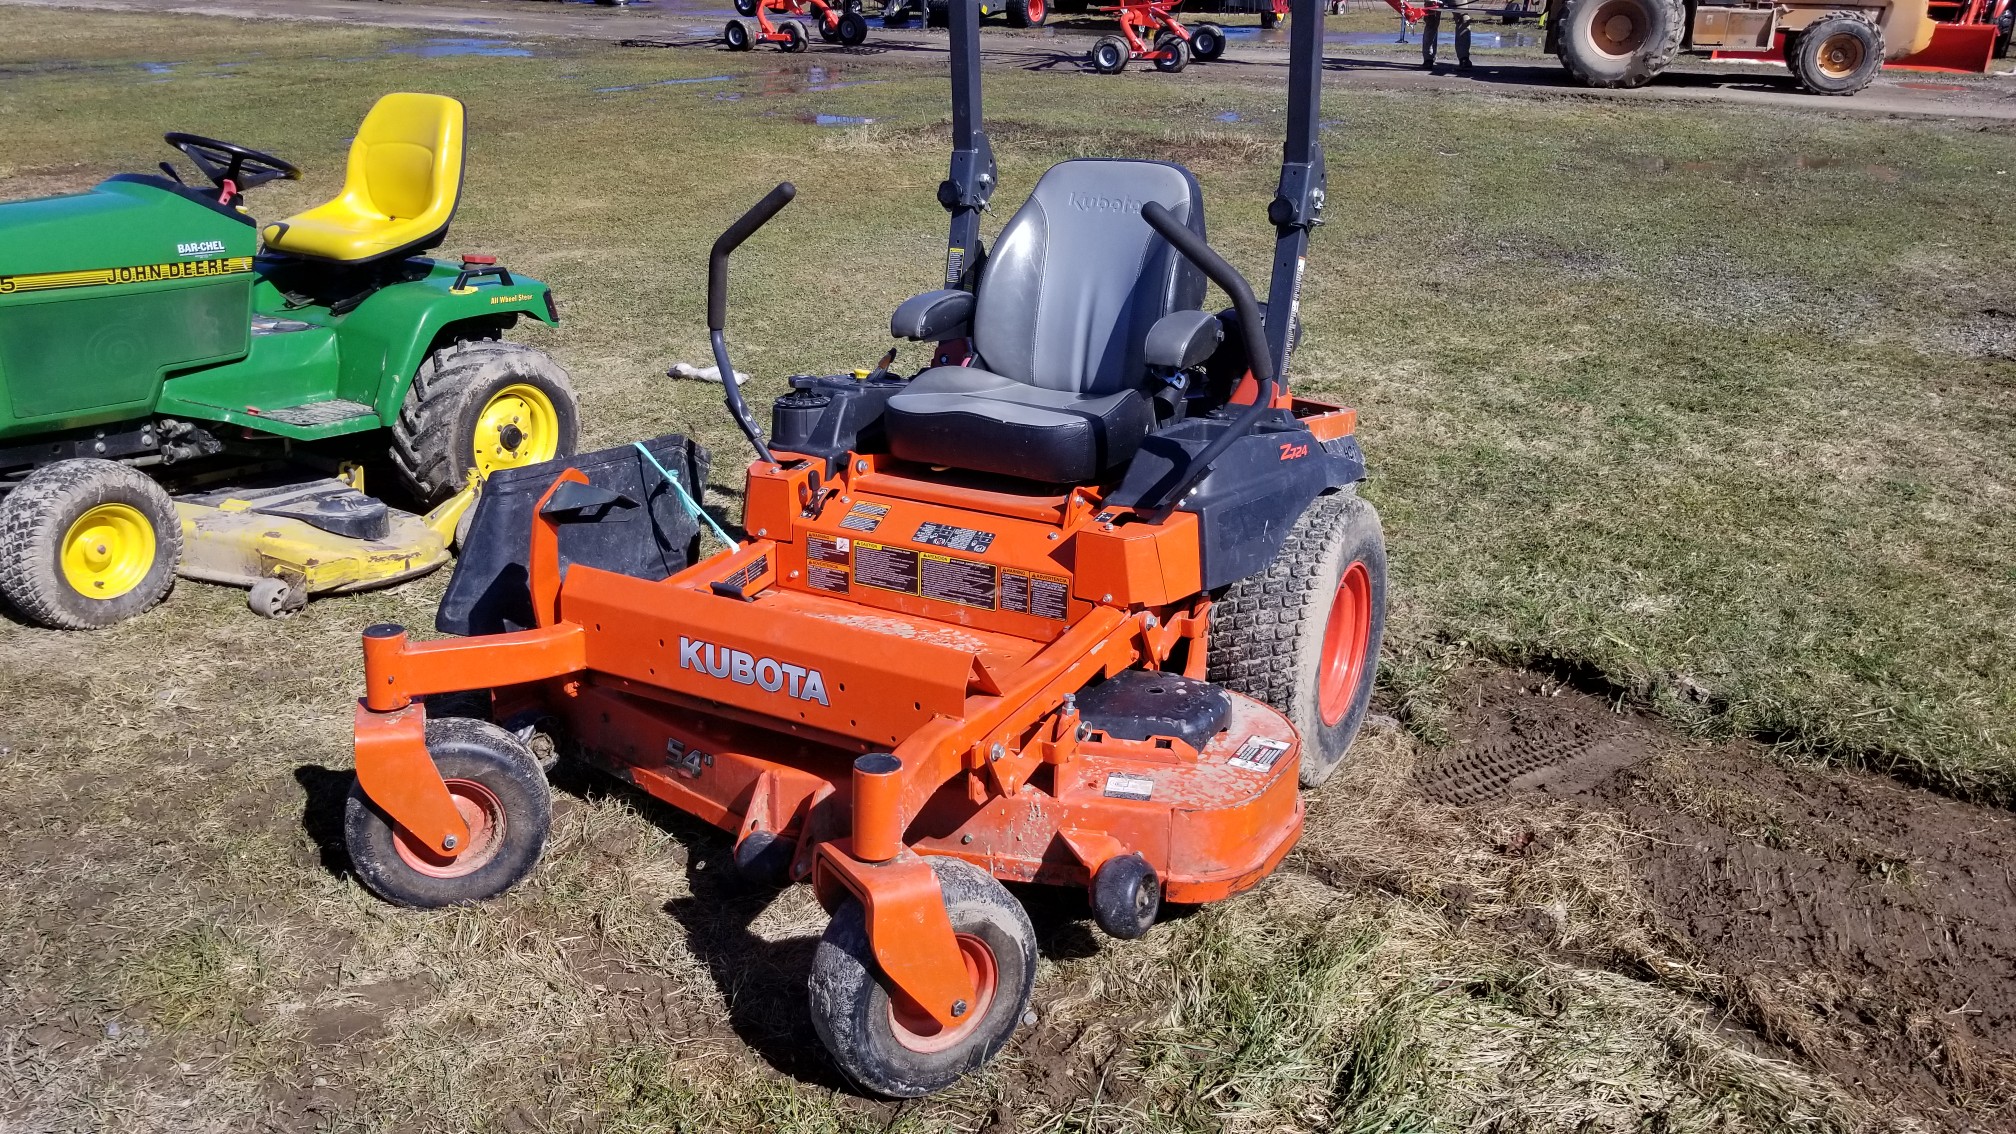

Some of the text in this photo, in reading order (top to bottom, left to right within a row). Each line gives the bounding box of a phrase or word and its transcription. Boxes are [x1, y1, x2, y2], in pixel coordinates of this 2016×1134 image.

[177, 241, 225, 254] BAR-CHEL
[107, 258, 230, 284] JOHN DEERE
[490, 294, 532, 305] All Wheel Steer
[1280, 443, 1308, 460] Z724
[860, 541, 878, 549] CAUTION
[1036, 573, 1068, 584] ADVERTENCIA
[679, 635, 831, 707] KUBOTA
